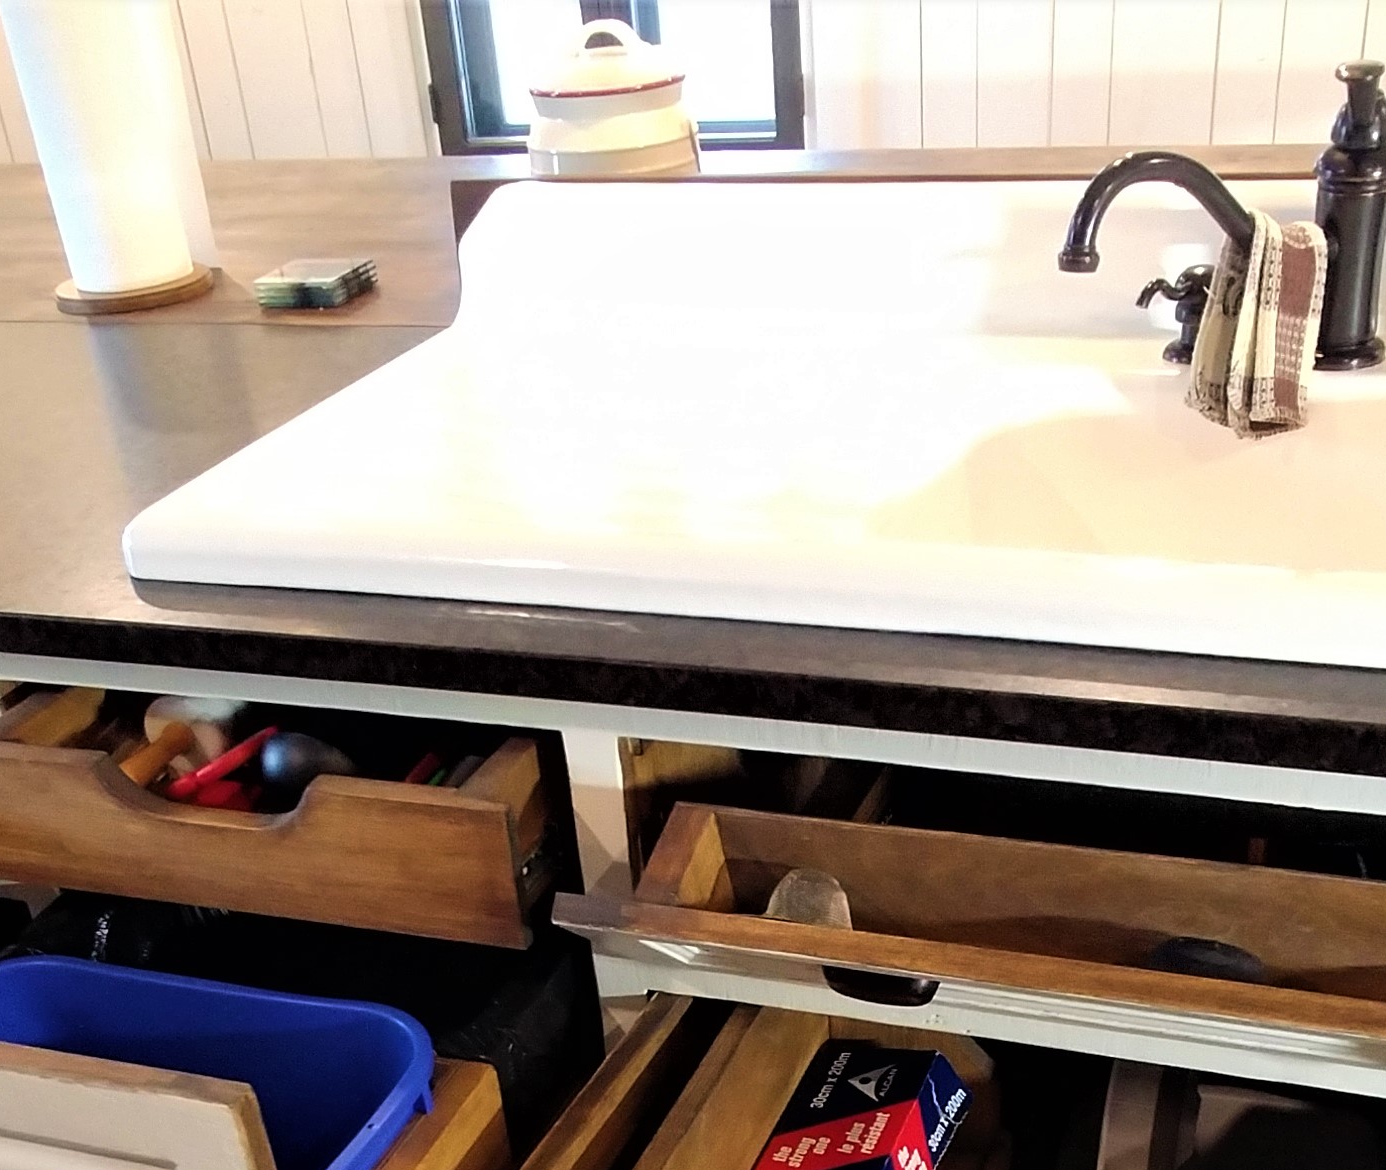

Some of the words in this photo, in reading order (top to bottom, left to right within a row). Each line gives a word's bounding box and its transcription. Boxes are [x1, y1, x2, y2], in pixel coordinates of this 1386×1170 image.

[810, 1080, 833, 1109] 30cm
[828, 1052, 851, 1077] 200m
[879, 1068, 898, 1097] ALCAN
[929, 1123, 946, 1152] 30cm
[945, 1088, 967, 1121] 200m
[773, 1145, 792, 1162] the
[788, 1137, 817, 1168] strong
[813, 1137, 831, 1154] one
[837, 1142, 854, 1154] le
[846, 1122, 865, 1144] plus
